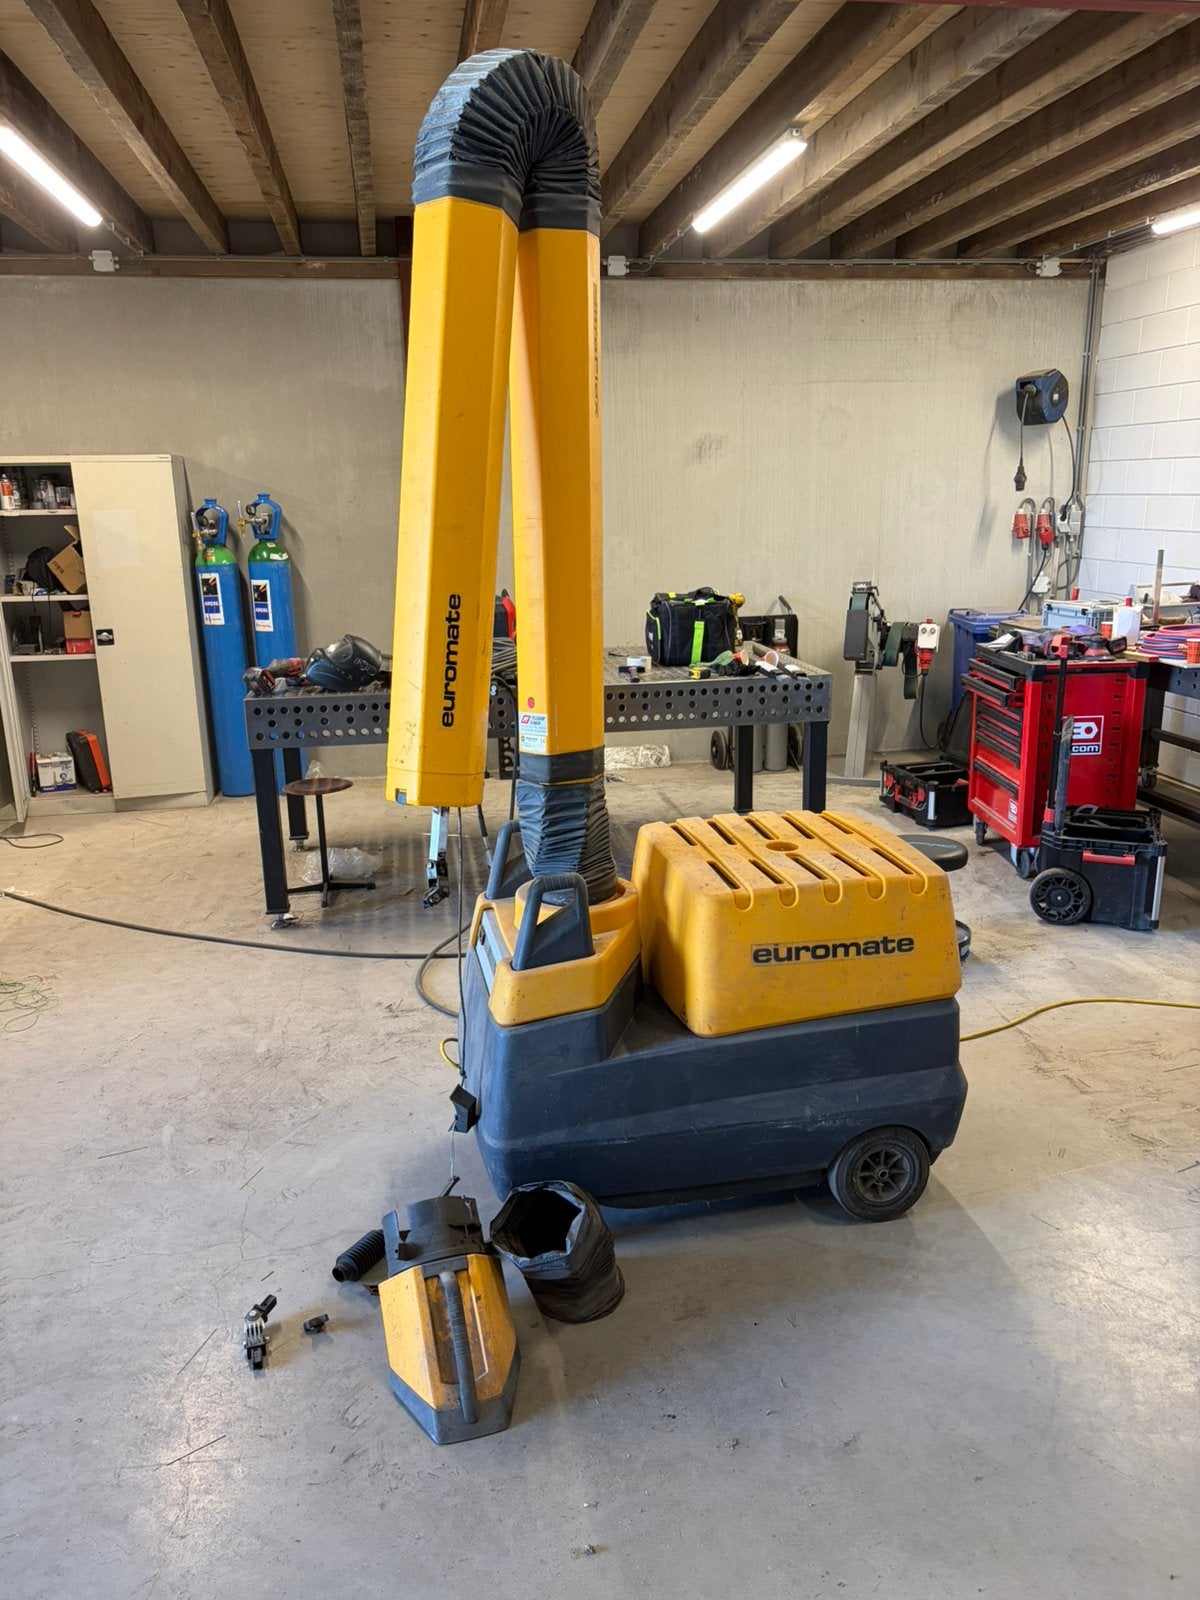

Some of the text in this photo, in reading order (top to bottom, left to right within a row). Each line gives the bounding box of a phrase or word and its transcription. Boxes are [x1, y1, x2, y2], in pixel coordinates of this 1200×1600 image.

[442, 593, 462, 728] euromate
[1071, 745, 1099, 753] com
[753, 936, 914, 964] euromate
